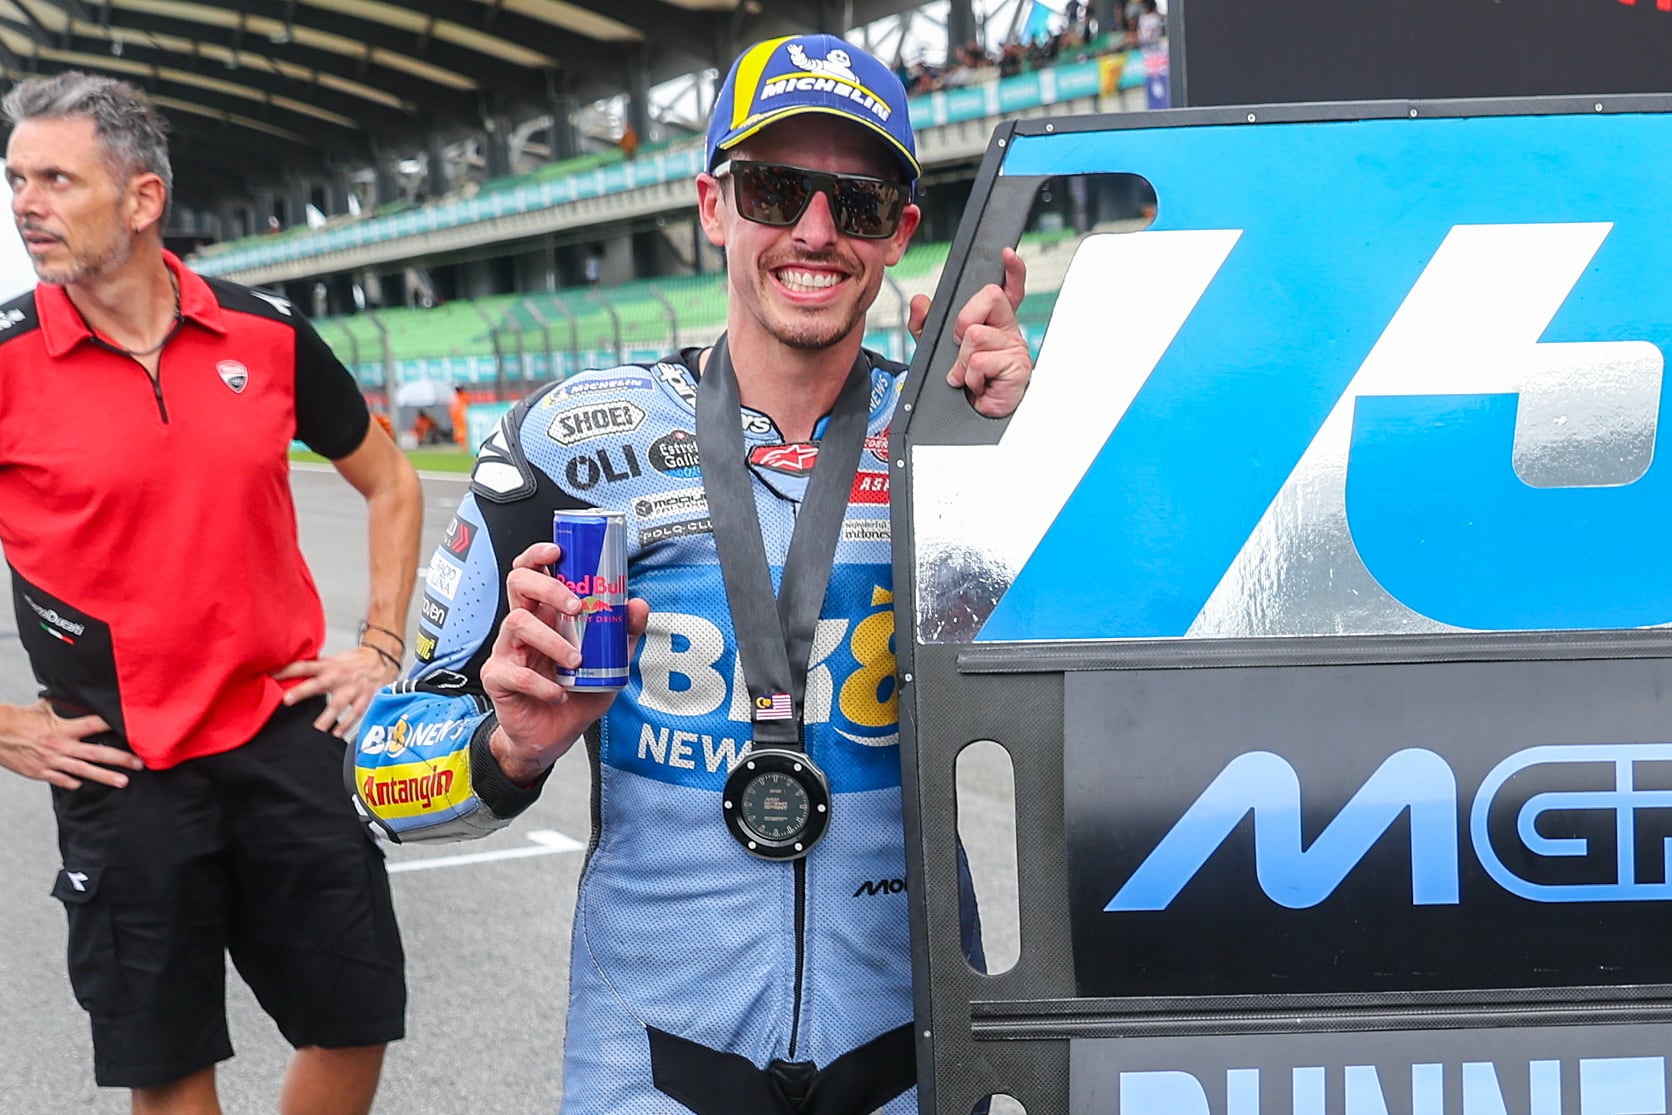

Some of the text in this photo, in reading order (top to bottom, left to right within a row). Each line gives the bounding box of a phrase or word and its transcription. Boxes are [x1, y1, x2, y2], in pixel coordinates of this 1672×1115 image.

[761, 76, 892, 122] MICHELIN
[571, 378, 643, 394] MICHELIN
[558, 405, 633, 438] SHOEI
[565, 444, 642, 491] OLI
[593, 575, 625, 594] Bull
[363, 765, 454, 809] Antangin
